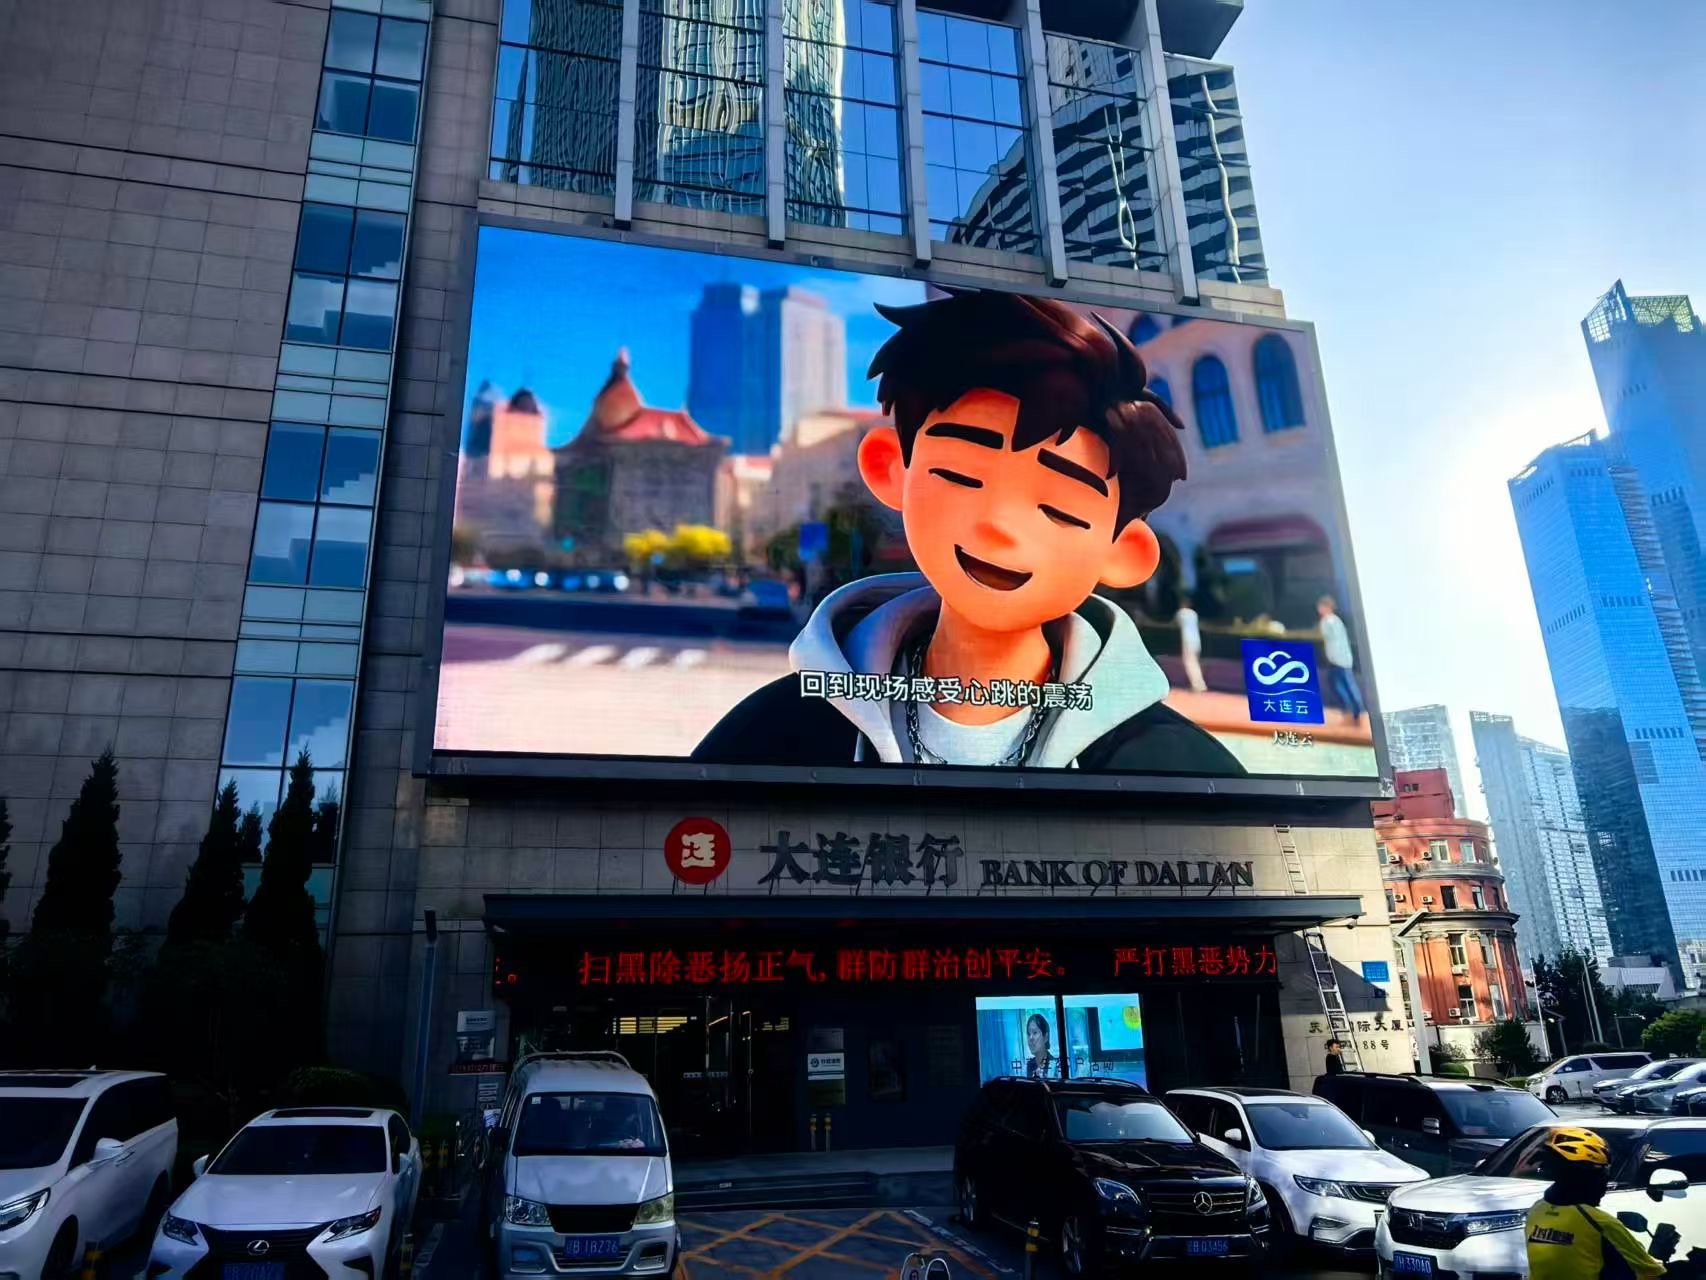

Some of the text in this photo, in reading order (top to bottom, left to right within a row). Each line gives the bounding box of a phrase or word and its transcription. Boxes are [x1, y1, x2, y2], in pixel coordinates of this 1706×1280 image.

[800, 670, 1094, 710] 回到现场感受心跳的震荡
[1263, 699, 1309, 715] 大连云
[757, 831, 964, 886] 大连银行
[979, 860, 1254, 888] BANK OF DALIAN
